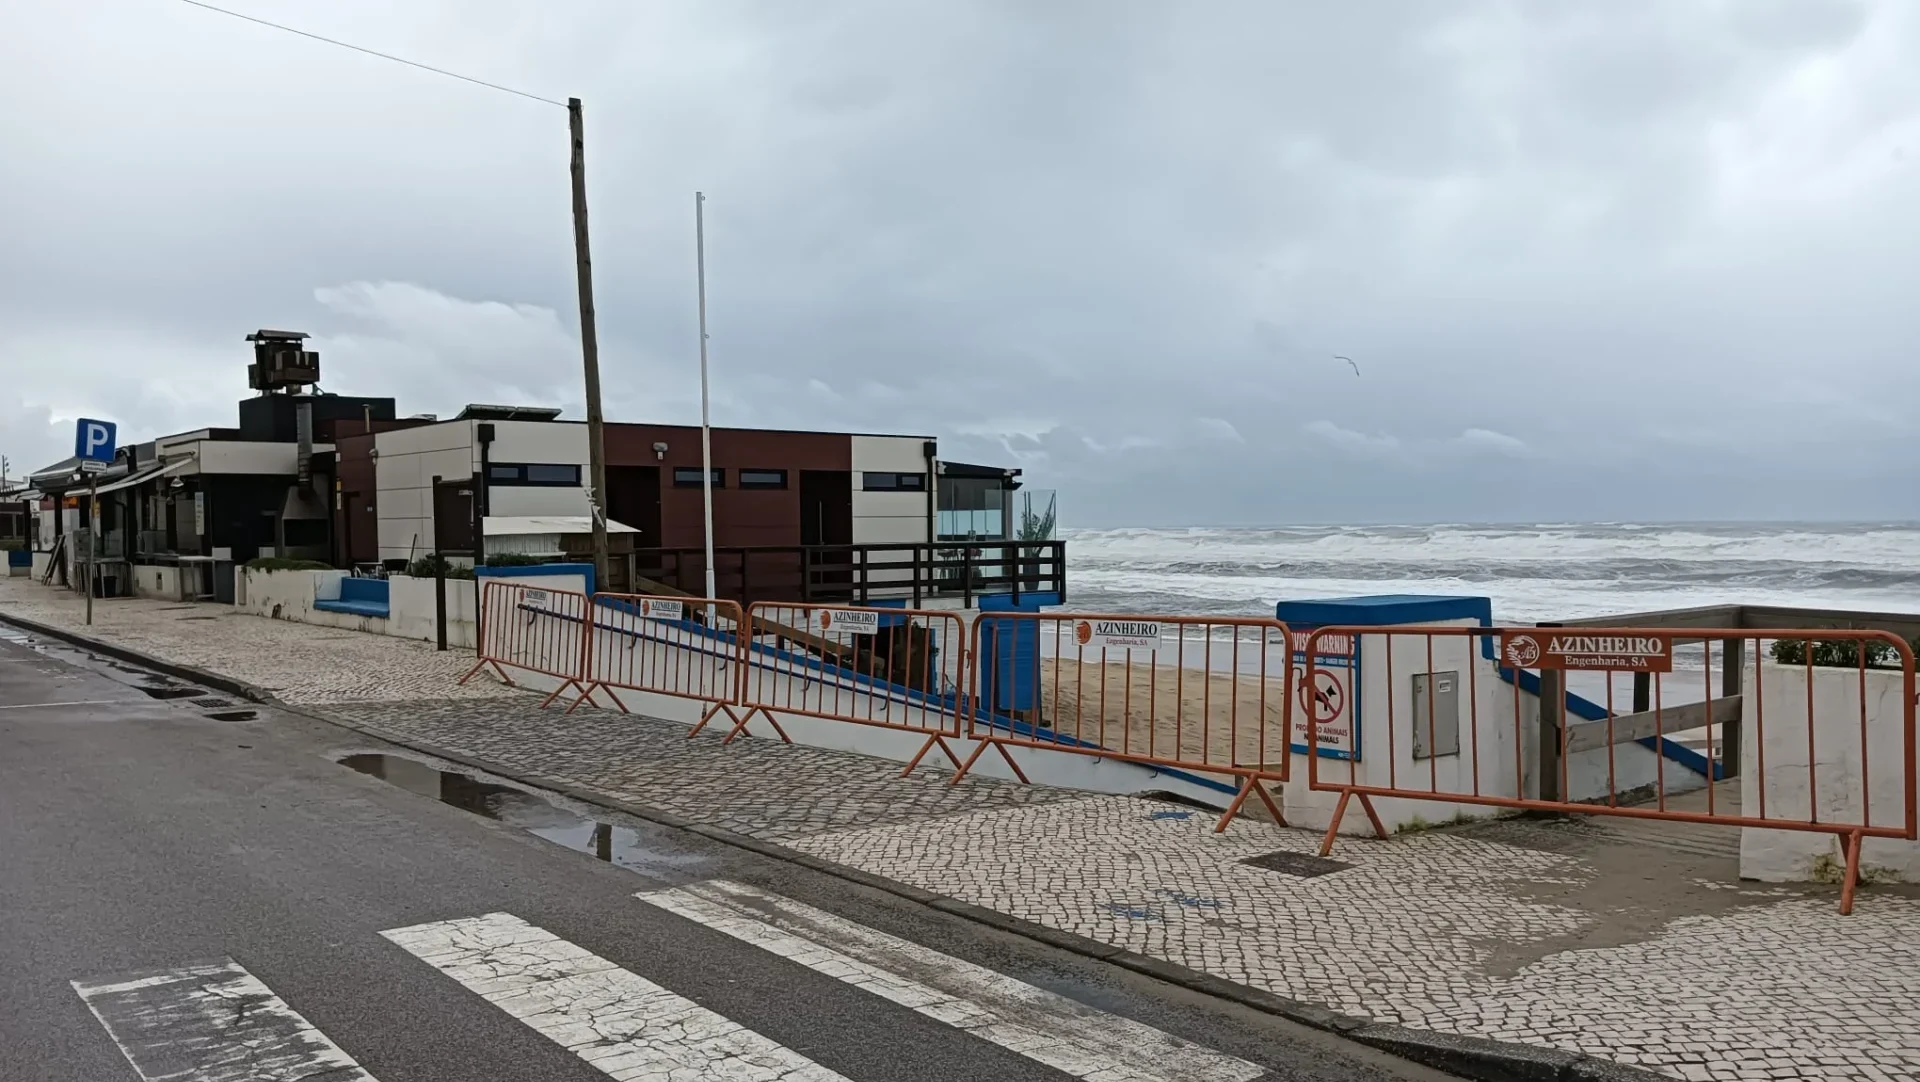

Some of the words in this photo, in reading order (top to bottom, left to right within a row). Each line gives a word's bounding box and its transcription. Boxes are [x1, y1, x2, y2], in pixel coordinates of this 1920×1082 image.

[86, 423, 108, 456] P
[652, 600, 680, 611] AZINHEIRO
[834, 611, 876, 623] AZINHEIRO
[1096, 621, 1158, 636] AZINHEIRO
[1548, 636, 1662, 653] AZINHEIRO
[1565, 655, 1629, 667] Engenharia,
[1631, 656, 1648, 667] SA
[1295, 723, 1322, 734] PROO
